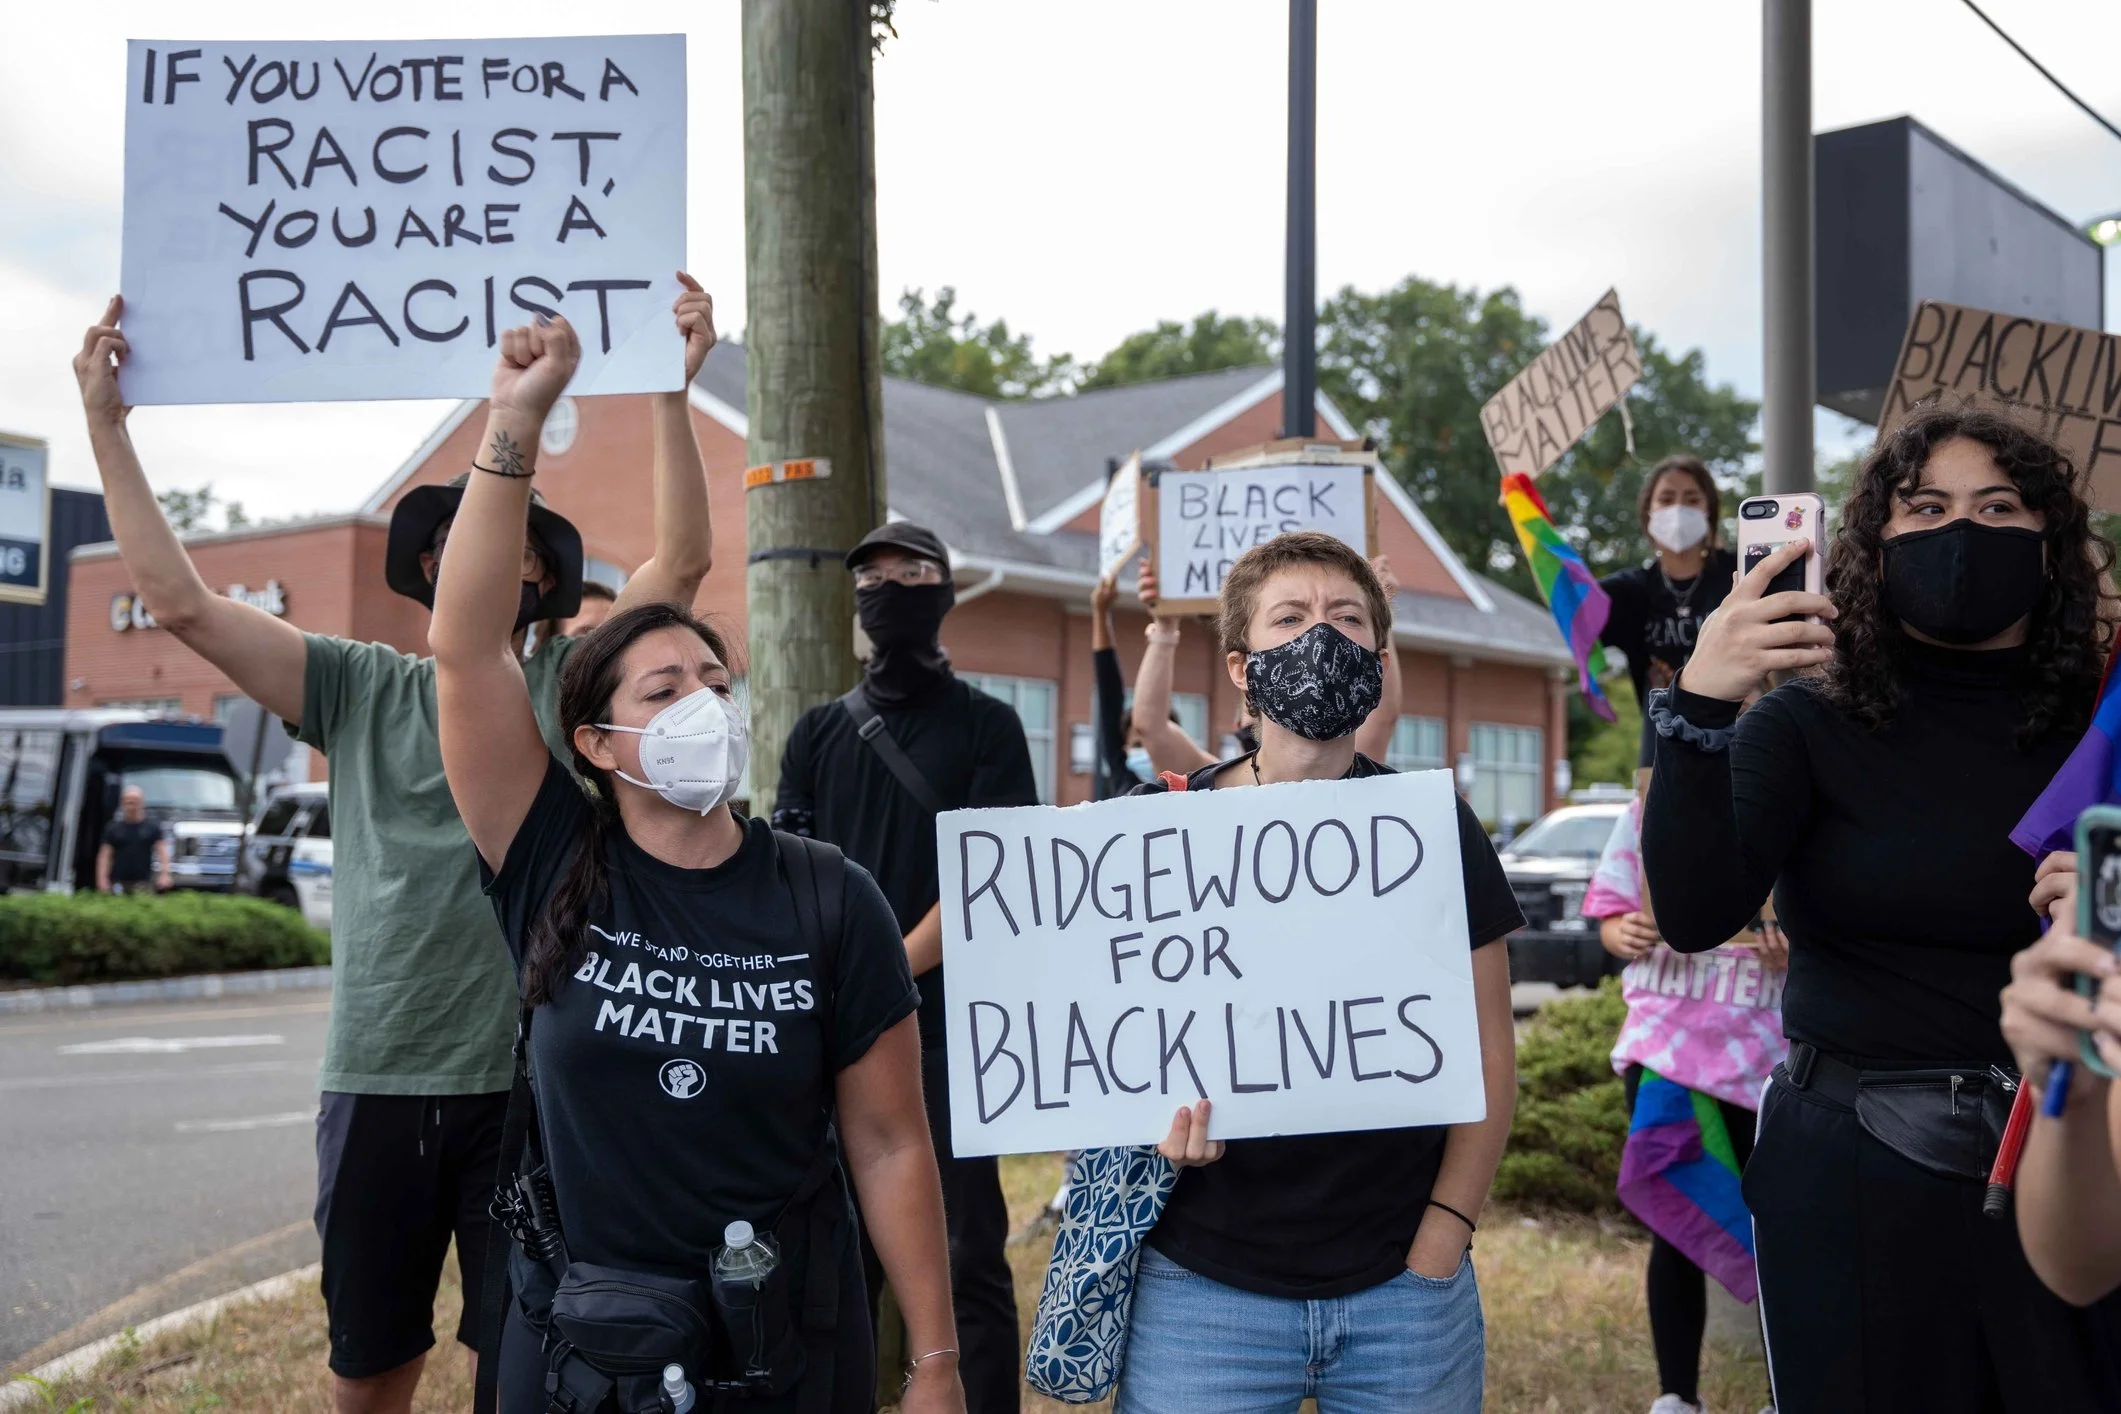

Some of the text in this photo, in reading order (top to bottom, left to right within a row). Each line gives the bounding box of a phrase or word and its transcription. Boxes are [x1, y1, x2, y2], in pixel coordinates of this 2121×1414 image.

[143, 49, 639, 105] IF YOU VOTE FOR A
[218, 195, 607, 258] YOU ARE A
[238, 269, 652, 361] RACIST
[1899, 302, 2071, 403] BLACK
[1485, 350, 1563, 447] BLACK
[1498, 338, 1638, 476] MATTER
[1179, 480, 1336, 519] BLACK
[1644, 615, 1704, 647] BLAC
[656, 756, 675, 766] KN95
[960, 816, 1423, 941] RIDGEWOOD
[615, 931, 775, 970] WE STAND TOGETHER
[1110, 926, 1242, 984] FOR
[573, 951, 815, 1011] BLACK LIVES
[594, 1000, 779, 1054] MATTER
[969, 994, 1443, 1124] BLACK LIVES
